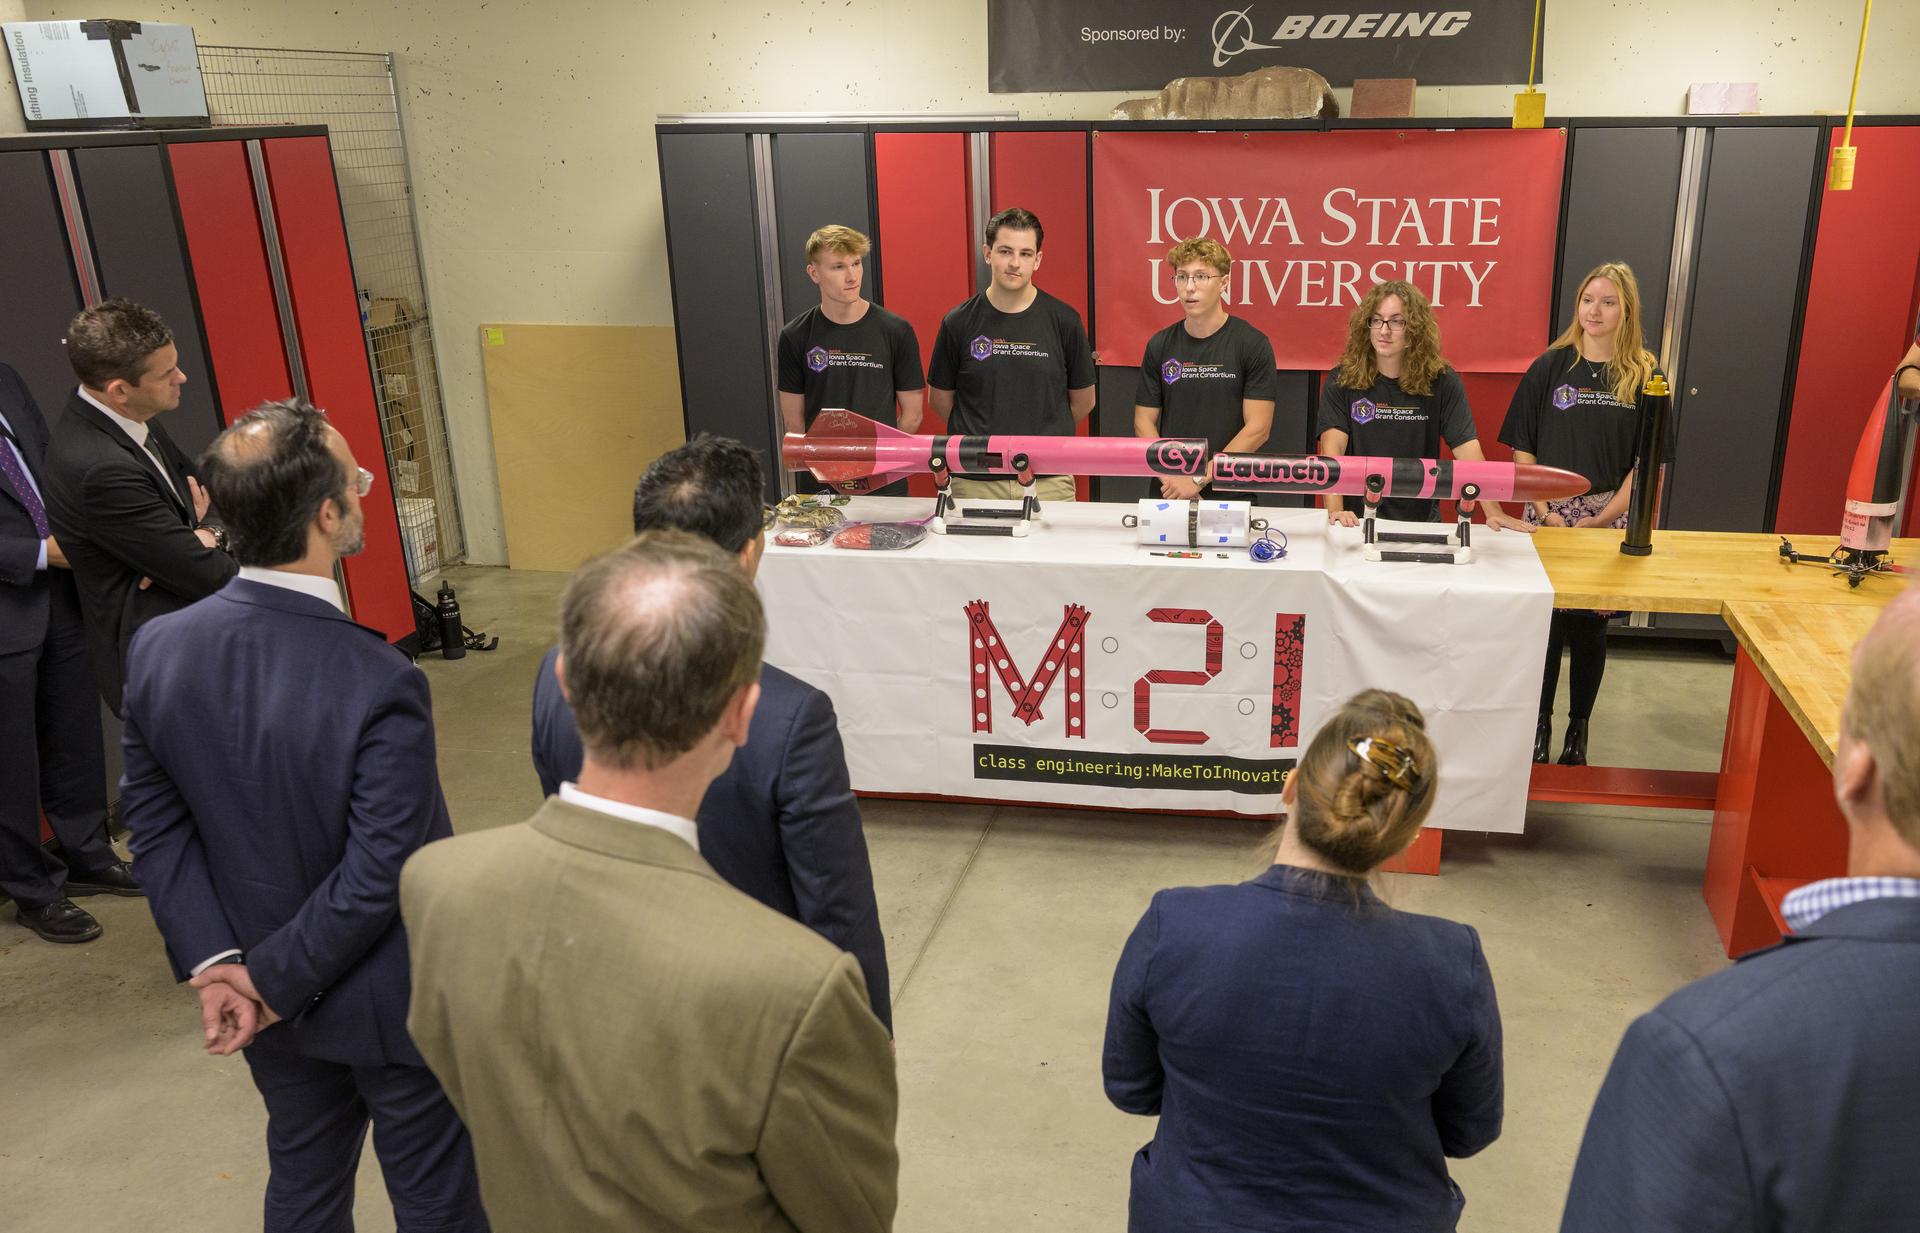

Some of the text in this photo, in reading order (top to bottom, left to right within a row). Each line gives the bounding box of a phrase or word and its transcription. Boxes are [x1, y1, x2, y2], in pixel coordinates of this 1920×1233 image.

[1081, 27, 1186, 44] Sponsored by:
[1272, 11, 1472, 40] BOEING
[14, 31, 34, 83] Insulation
[1320, 187, 1501, 246] STATE
[848, 360, 884, 369] Consortium
[1012, 349, 1048, 357] Consortium
[1213, 453, 1330, 486] Launch
[978, 754, 1289, 783] class engineering:MakeToInnovate
